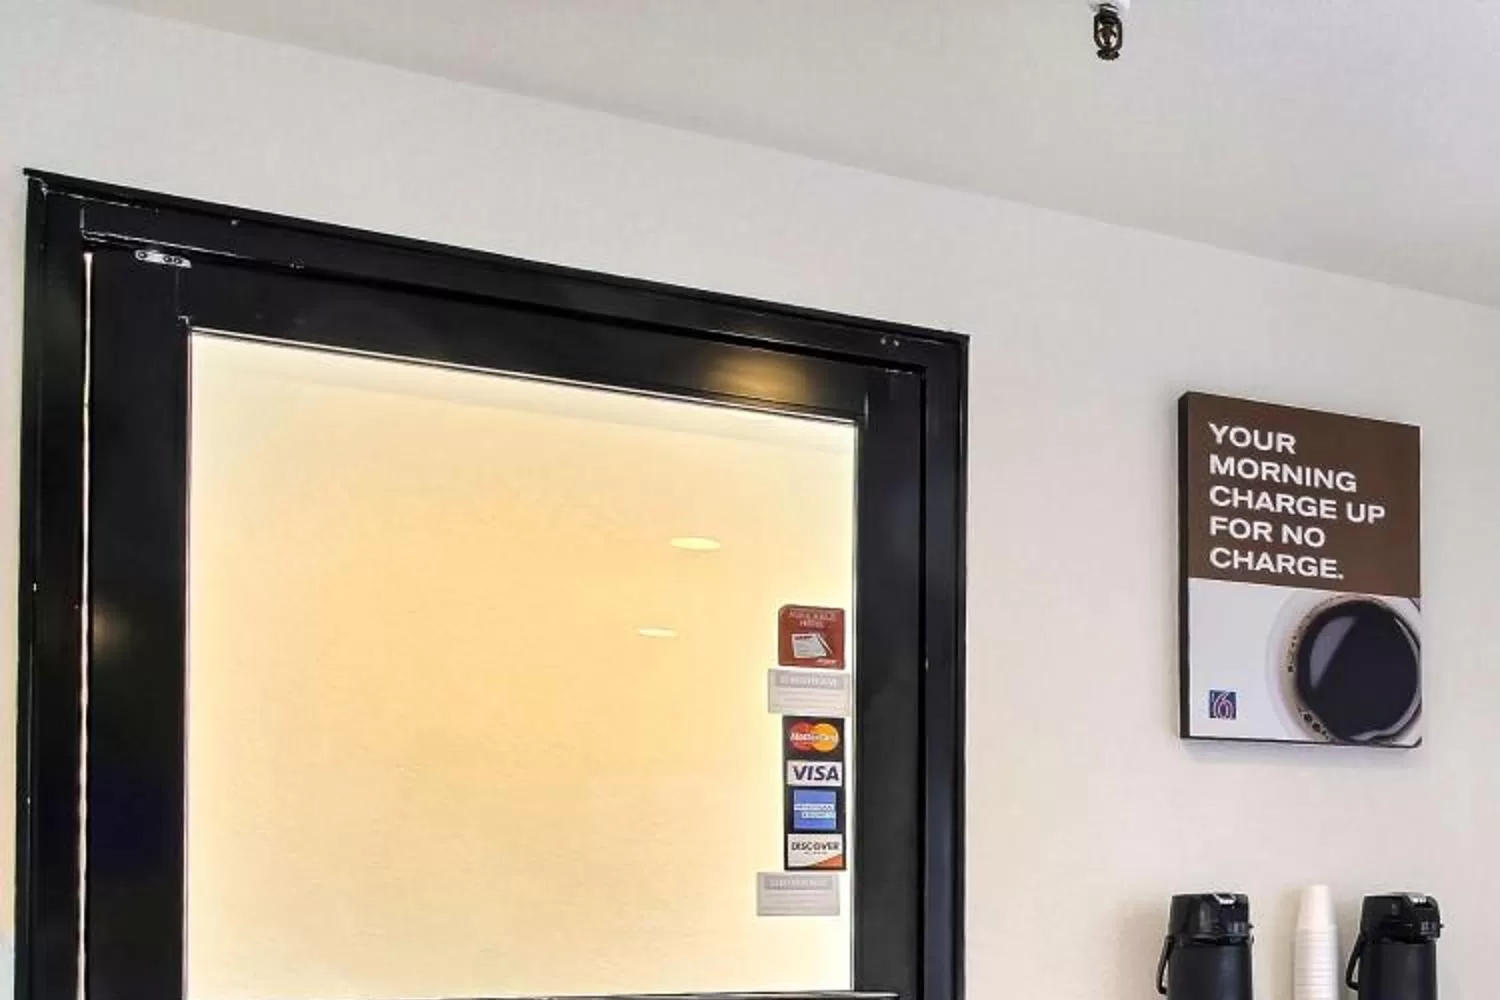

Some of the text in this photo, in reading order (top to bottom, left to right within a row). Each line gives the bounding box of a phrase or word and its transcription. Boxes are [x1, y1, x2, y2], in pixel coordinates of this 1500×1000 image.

[1208, 423, 1297, 455] YOUR
[1209, 453, 1357, 493] MORNING
[1209, 485, 1386, 525] CHARGE UP
[1209, 515, 1326, 548] FOR NO
[1209, 547, 1344, 580] CHARGE.
[793, 765, 840, 781] VISA
[791, 841, 840, 851] DISCOVER
